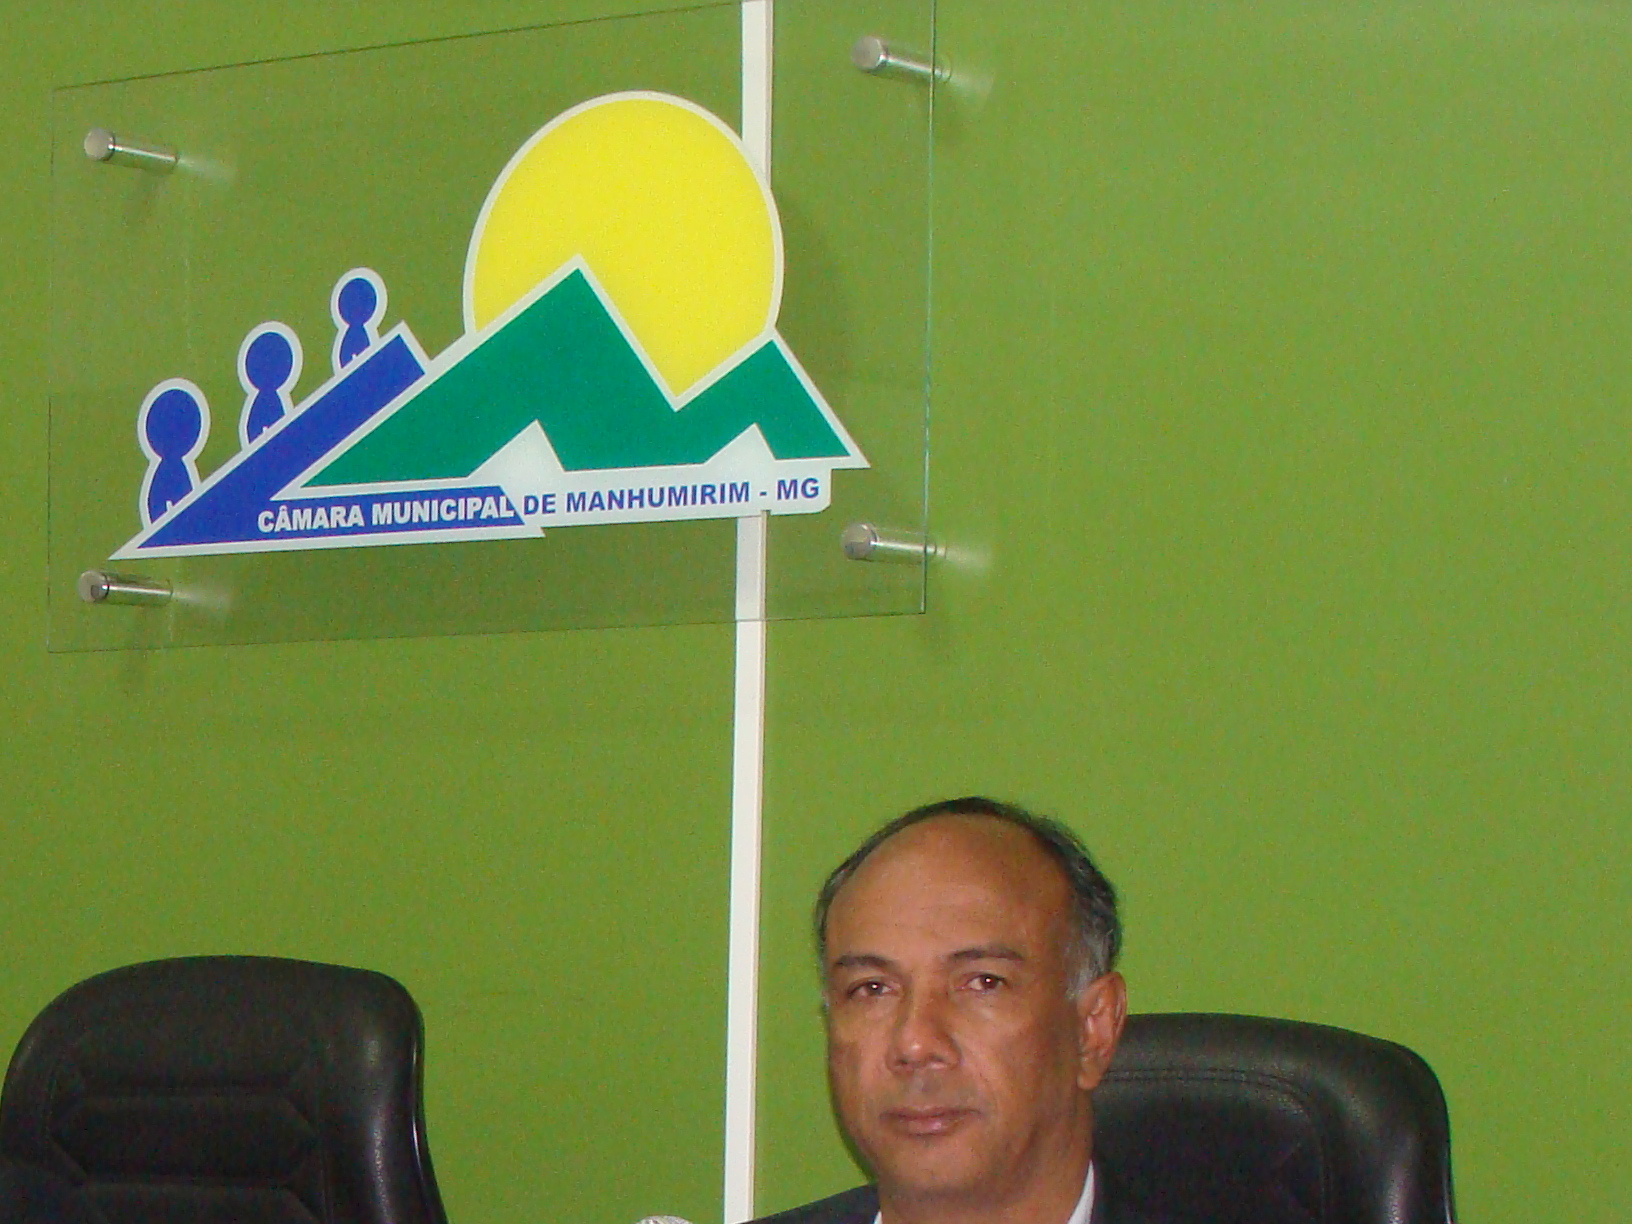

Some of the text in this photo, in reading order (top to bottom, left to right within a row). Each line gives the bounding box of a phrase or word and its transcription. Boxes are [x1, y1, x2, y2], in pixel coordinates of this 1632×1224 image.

[257, 504, 365, 533] CÂMARA
[371, 495, 515, 526] MUNICIPAL
[523, 493, 557, 516] DE
[565, 481, 751, 513] MANHUMIRIM
[776, 477, 820, 501] MG
